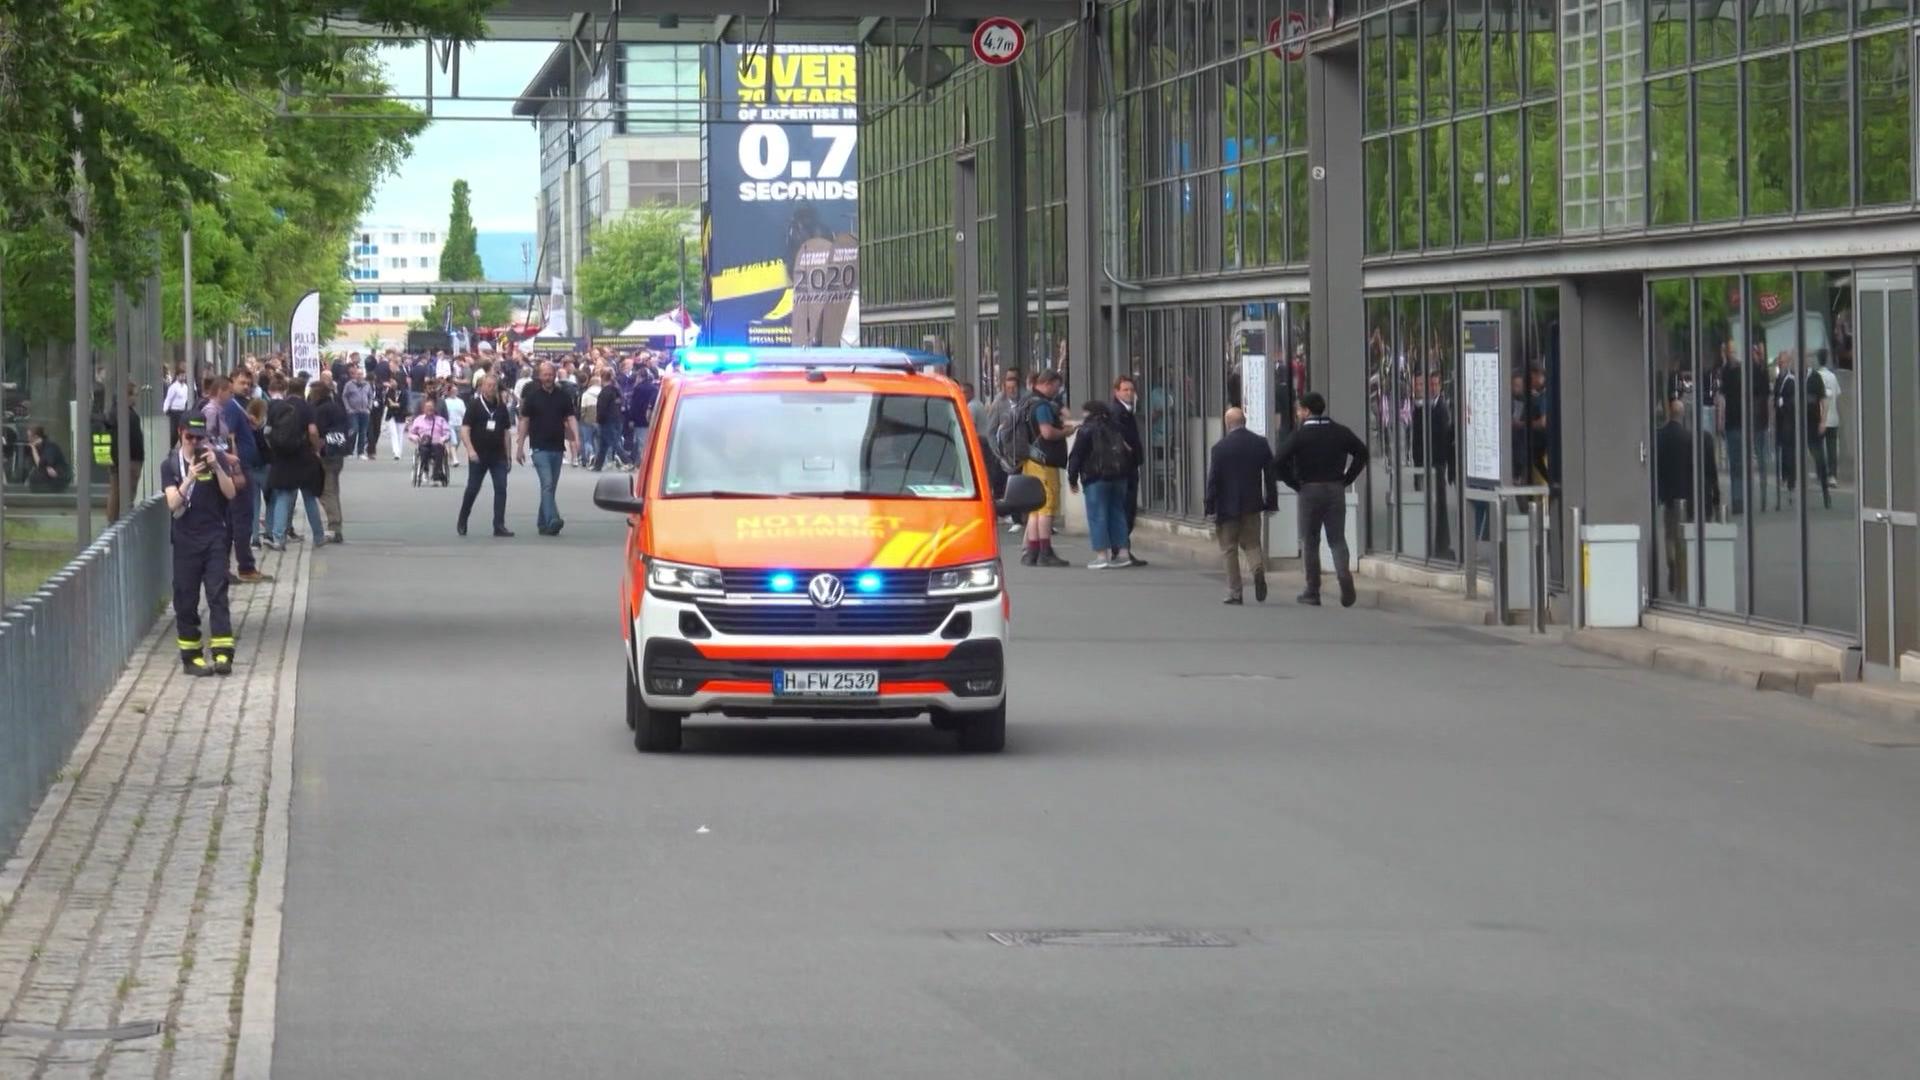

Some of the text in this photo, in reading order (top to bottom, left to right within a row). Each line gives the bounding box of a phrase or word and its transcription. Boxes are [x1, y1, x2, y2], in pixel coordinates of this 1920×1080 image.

[738, 54, 857, 88] OVER
[738, 88, 857, 107] 70 YEARS
[738, 108, 857, 121] OF EXPERTISE IN
[738, 123, 857, 180] 0.7
[739, 181, 857, 201] SECONDS
[736, 514, 904, 529] NOTARZT
[736, 528, 885, 540] FEUERWEHR
[785, 672, 876, 690] H FW 2539
